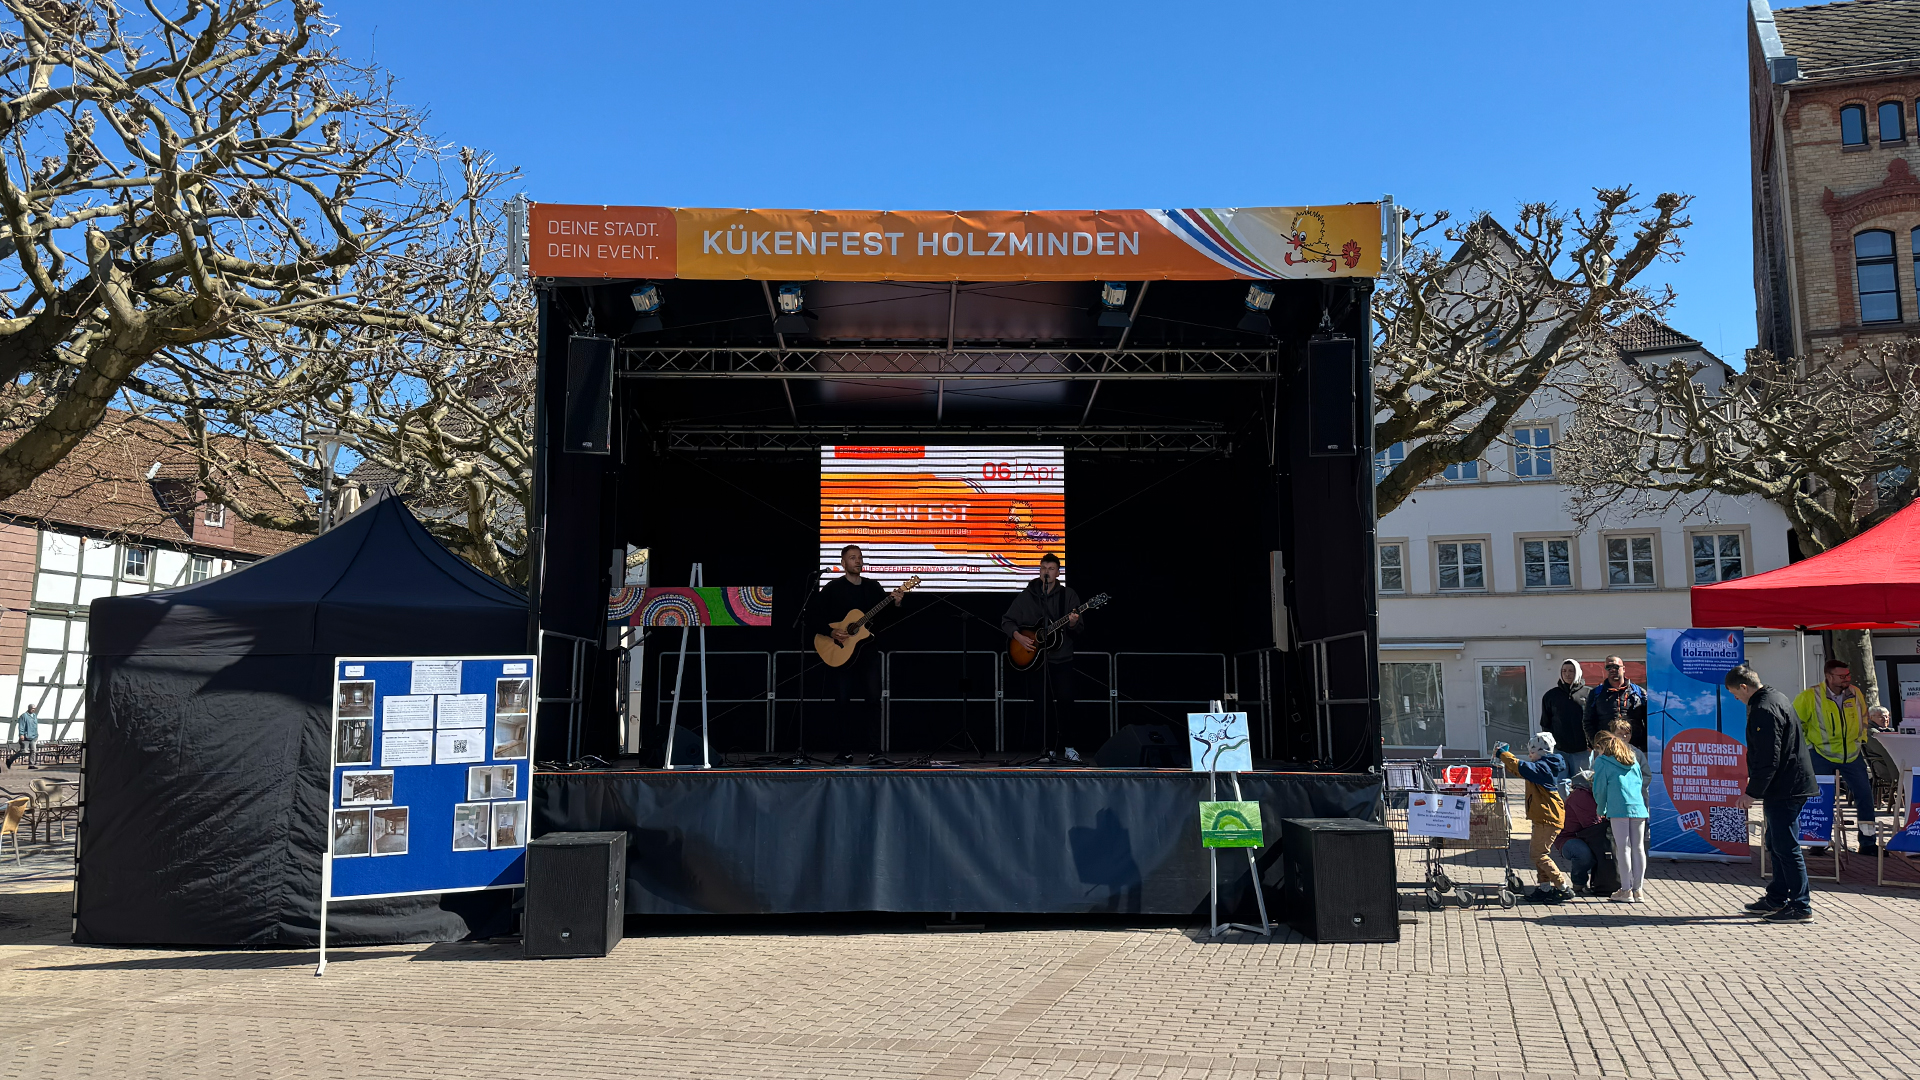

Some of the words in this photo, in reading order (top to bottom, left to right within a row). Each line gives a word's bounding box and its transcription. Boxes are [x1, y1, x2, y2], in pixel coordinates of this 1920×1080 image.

[548, 220, 599, 236] DEINE
[604, 221, 659, 237] STADT.
[703, 224, 905, 256] KÜKENFEST
[917, 231, 1139, 256] HOLZMINDEN
[548, 243, 590, 258] DEIN
[598, 245, 660, 260] EVENT.
[982, 462, 1011, 480] 06
[1022, 462, 1057, 484] Apr
[833, 499, 971, 520] KÜKENFEST
[1682, 640, 1734, 649] Stadtwerke
[1682, 648, 1737, 658] Holzminden
[1672, 742, 1696, 753] JETZT
[1698, 743, 1743, 755] WECHSELN
[1672, 754, 1689, 764] UND
[1692, 752, 1738, 766] ÖKOSTROM
[1672, 765, 1708, 776] SICHERN
[1685, 778, 1709, 786] BERATEN
[1673, 785, 1682, 793] BEI
[1701, 786, 1742, 796] ENTSCHEIDUNG
[1682, 793, 1727, 802] NACHHALTIGKEIT
[1681, 811, 1699, 822] SCAN
